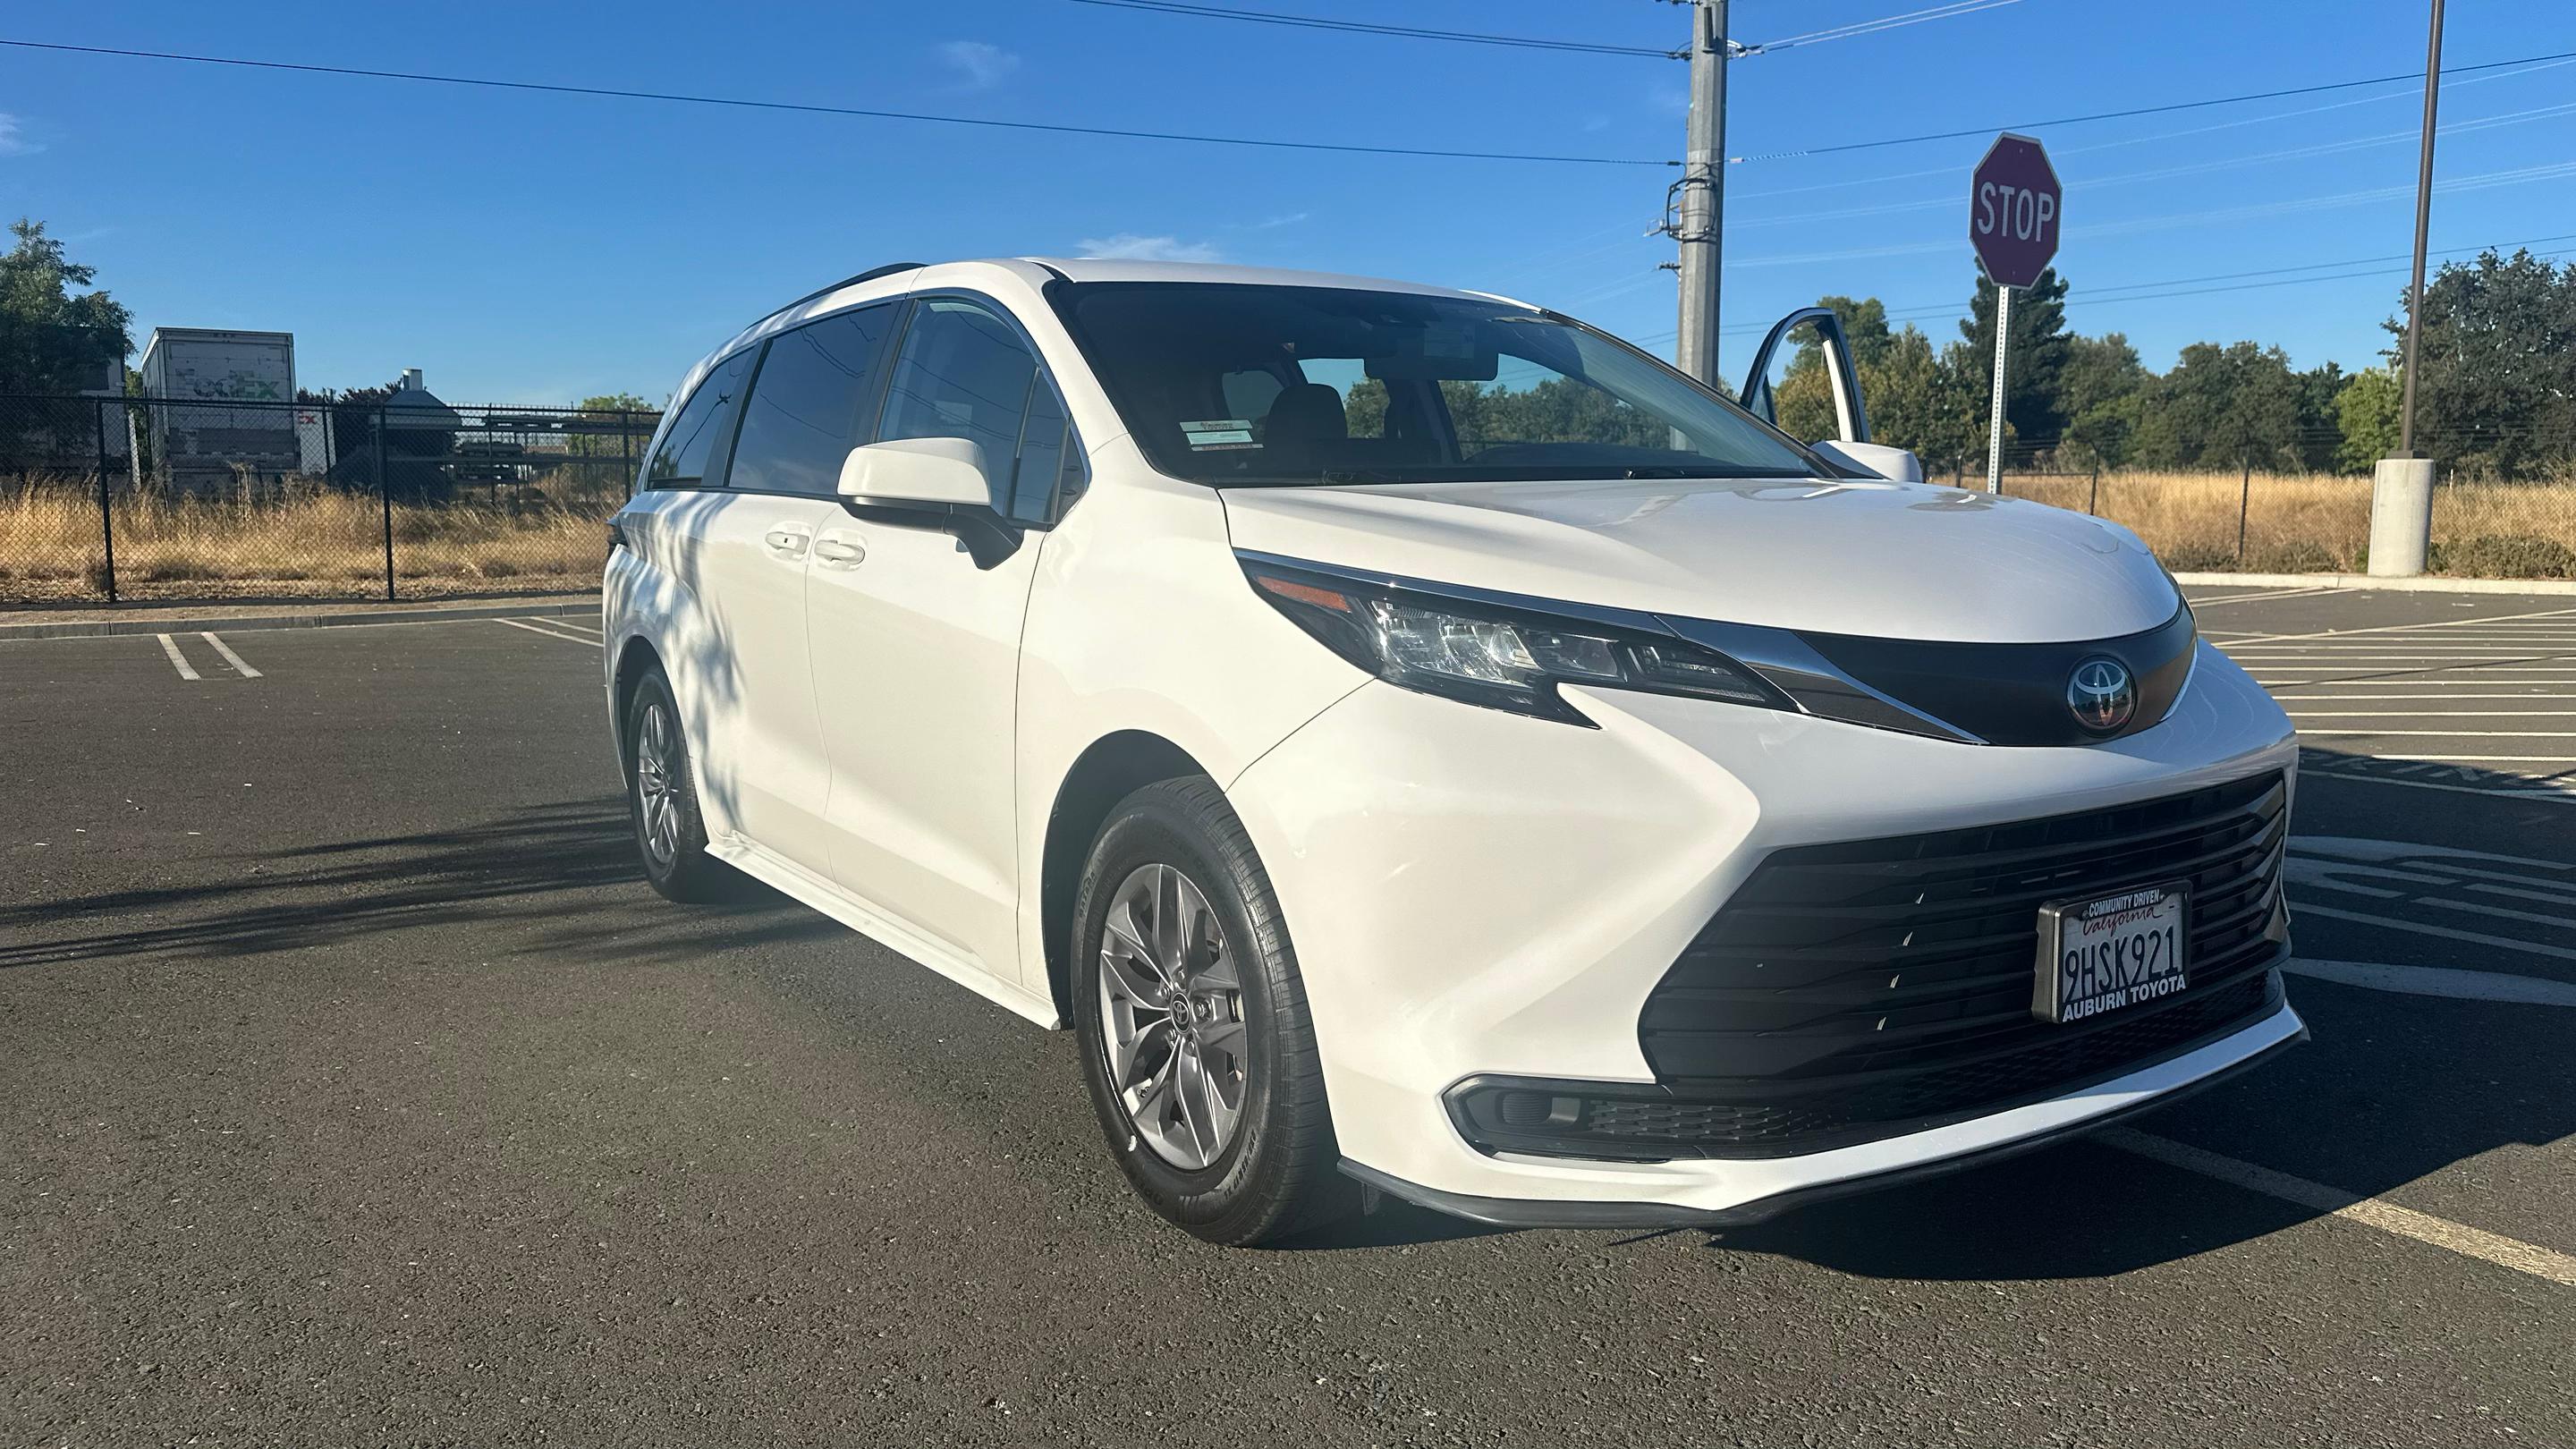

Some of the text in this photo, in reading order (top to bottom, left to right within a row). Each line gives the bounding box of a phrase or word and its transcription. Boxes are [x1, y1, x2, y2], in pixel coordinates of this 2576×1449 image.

[1977, 182, 2055, 242] STOP
[2083, 906, 2164, 936] California
[2089, 889, 2161, 917] COMMUNITY DRIVEN
[2064, 925, 2179, 1002] 9HSK921
[2063, 974, 2187, 1022] AUBURN TOYOTA
